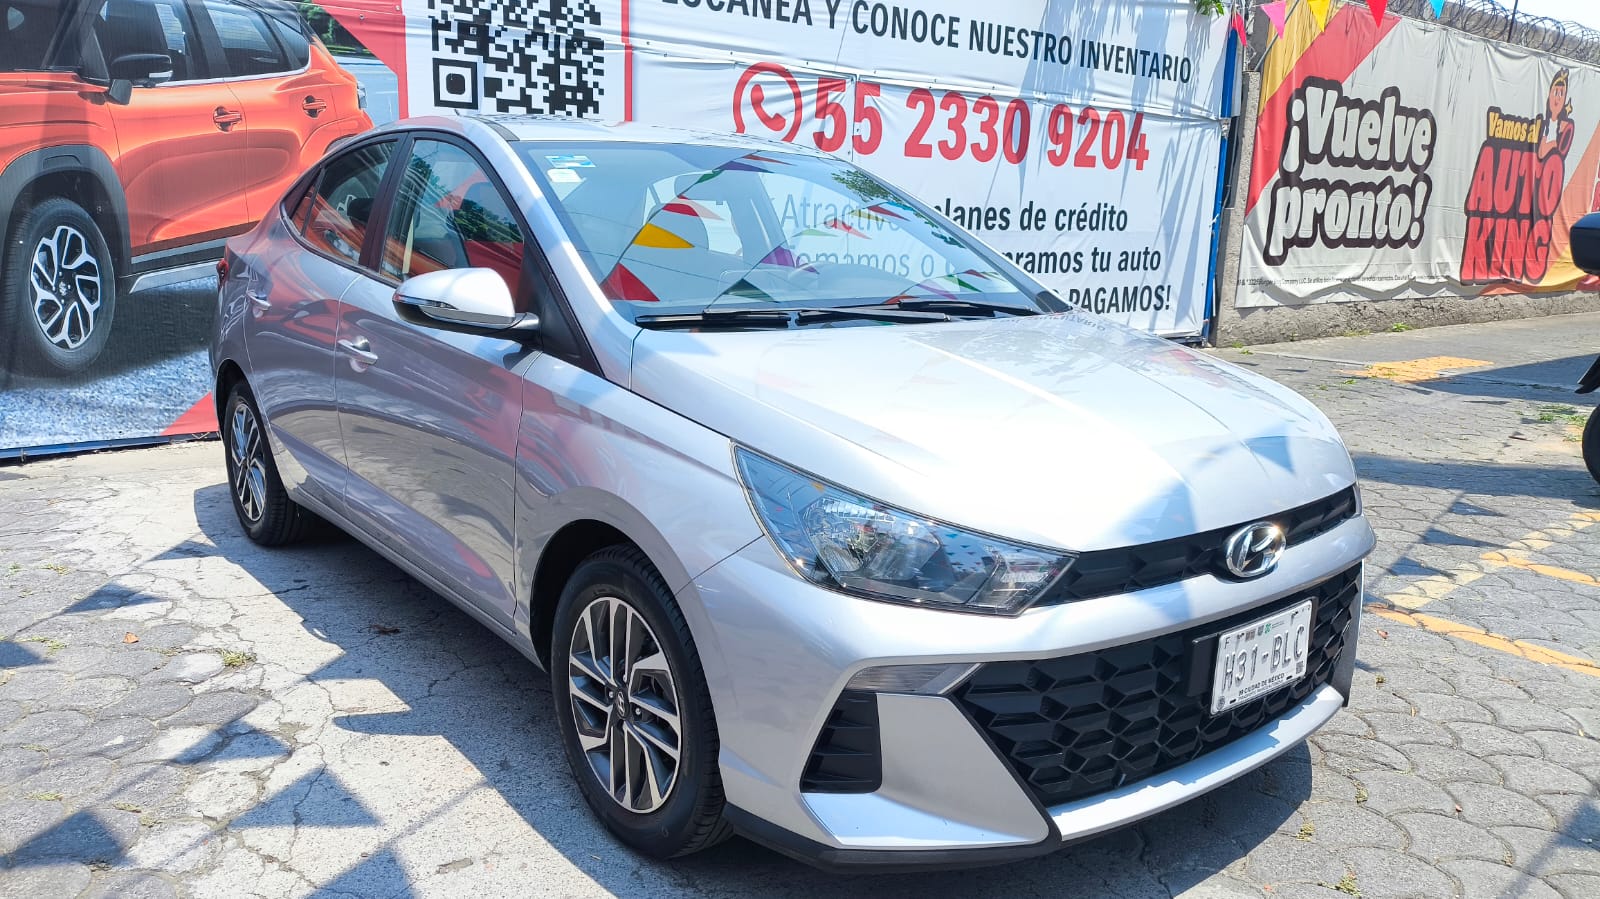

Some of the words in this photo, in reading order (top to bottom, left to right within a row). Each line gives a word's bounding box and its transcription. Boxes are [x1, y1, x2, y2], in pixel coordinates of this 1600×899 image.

[825, 0, 842, 29] Y
[852, 0, 960, 48] CONOCE
[969, 20, 1072, 65] NUESTRO
[1080, 39, 1192, 84] INVENTARIO
[812, 77, 883, 155] 55
[904, 88, 1031, 165] 2330
[1047, 103, 1150, 171] 9204
[1282, 84, 1433, 173] ¡Vuelve
[1488, 111, 1528, 142] Vamos
[1527, 119, 1541, 143] al
[934, 197, 1011, 231] lanes
[1020, 200, 1047, 231] de
[1054, 202, 1128, 232] crédito
[1466, 145, 1564, 217] AUTO
[1268, 180, 1428, 257] pronto!
[1460, 216, 1551, 281] KING
[1091, 246, 1111, 272] tu
[1117, 246, 1161, 272] auto
[1068, 284, 1171, 315] PAGAMOS!
[1222, 624, 1305, 693] H31-BLC
